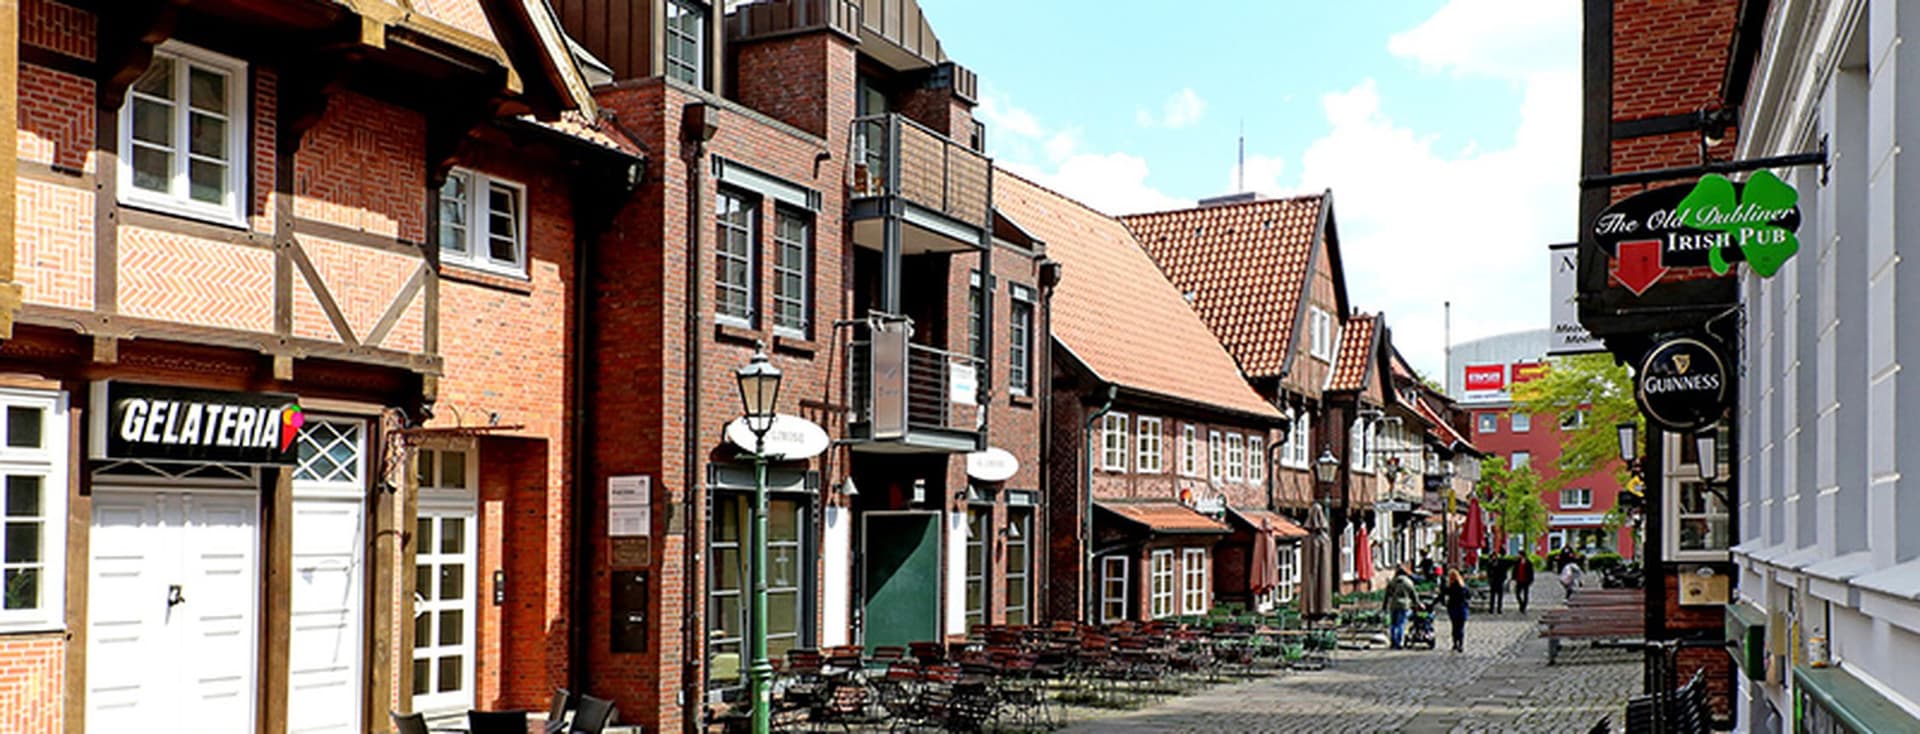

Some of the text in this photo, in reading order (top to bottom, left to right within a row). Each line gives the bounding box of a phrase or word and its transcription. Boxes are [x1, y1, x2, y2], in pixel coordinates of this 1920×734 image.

[1595, 203, 1796, 234] The Old Dubliner
[1645, 374, 1720, 394] GUINNESS
[120, 398, 281, 448] GELATERIA
